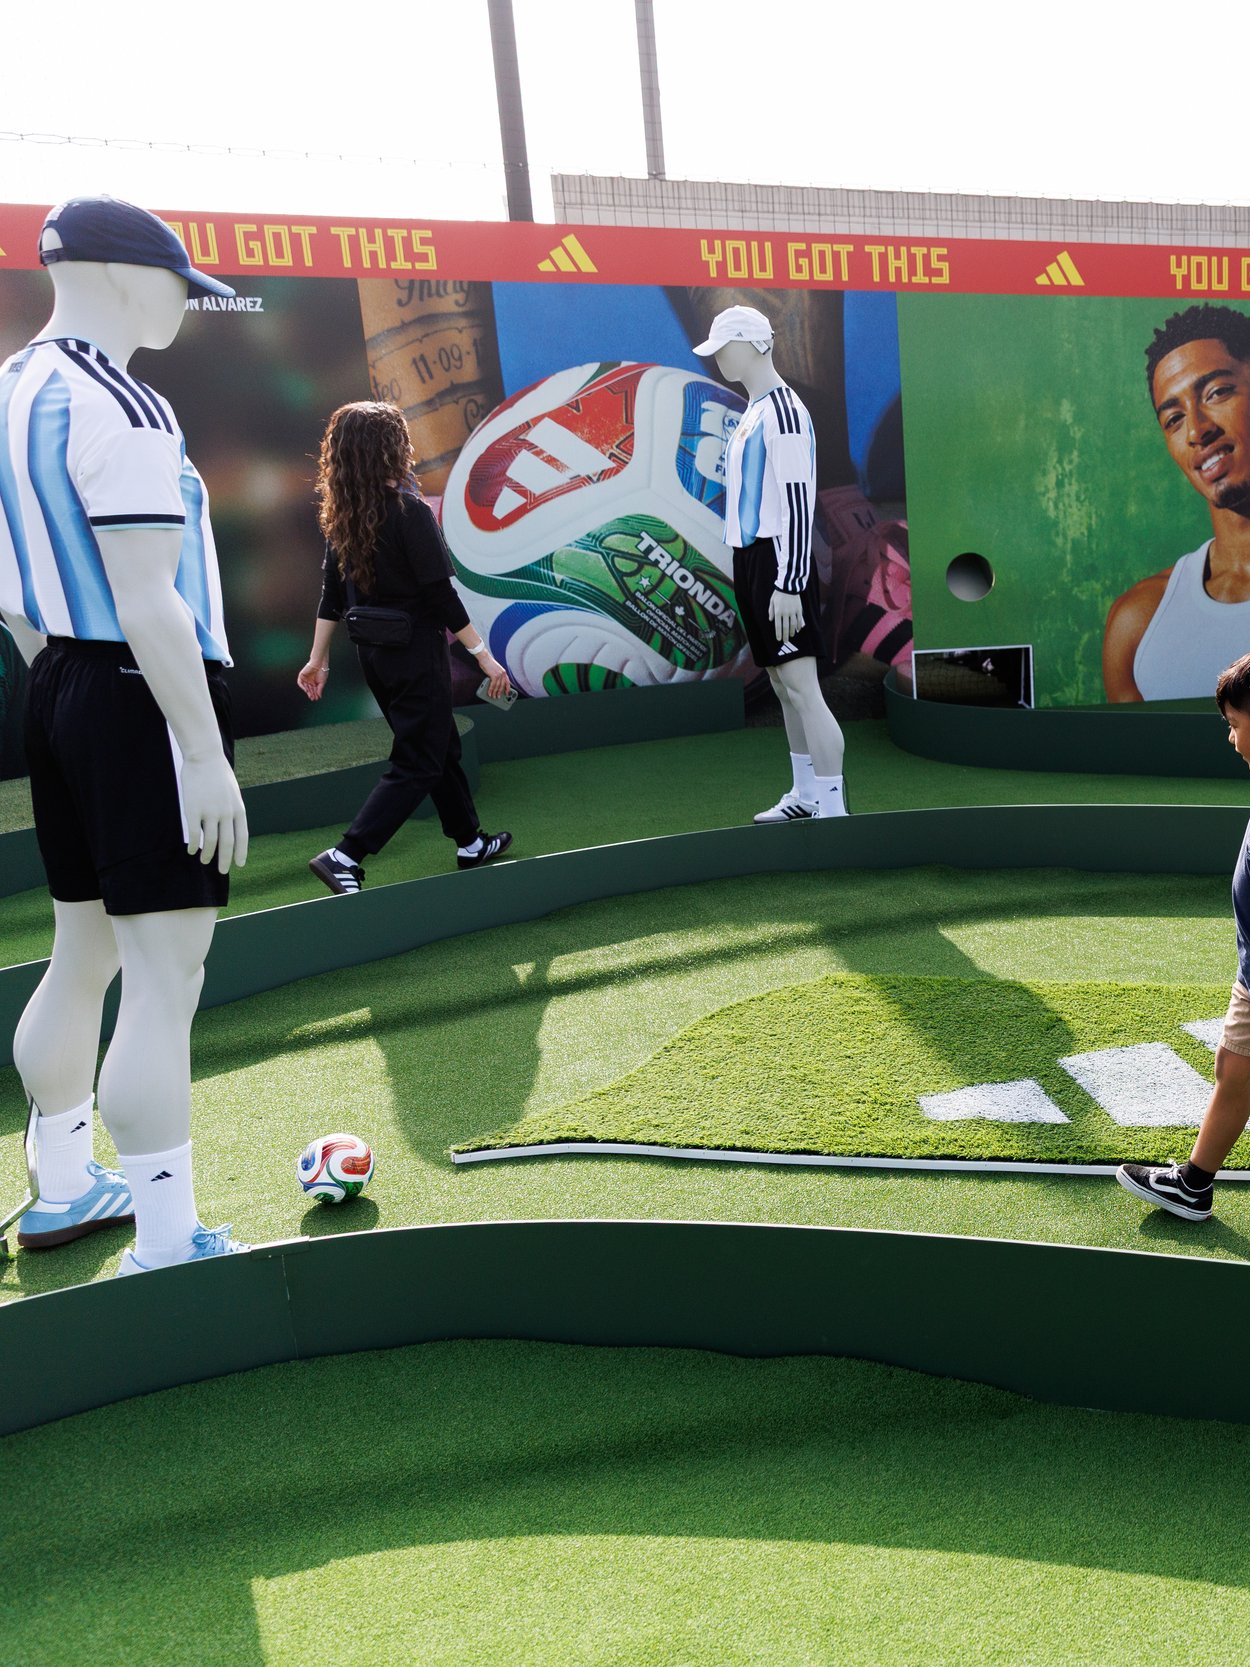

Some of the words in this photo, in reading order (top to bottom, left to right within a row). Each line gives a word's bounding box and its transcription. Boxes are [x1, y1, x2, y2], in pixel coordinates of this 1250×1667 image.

[234, 223, 317, 267] GOT
[330, 226, 437, 270] THIS
[700, 239, 774, 280] YOU
[787, 242, 854, 282] GOT
[864, 244, 950, 284] THIS
[1170, 255, 1229, 291] YOU
[636, 531, 737, 629] TRIONDA
